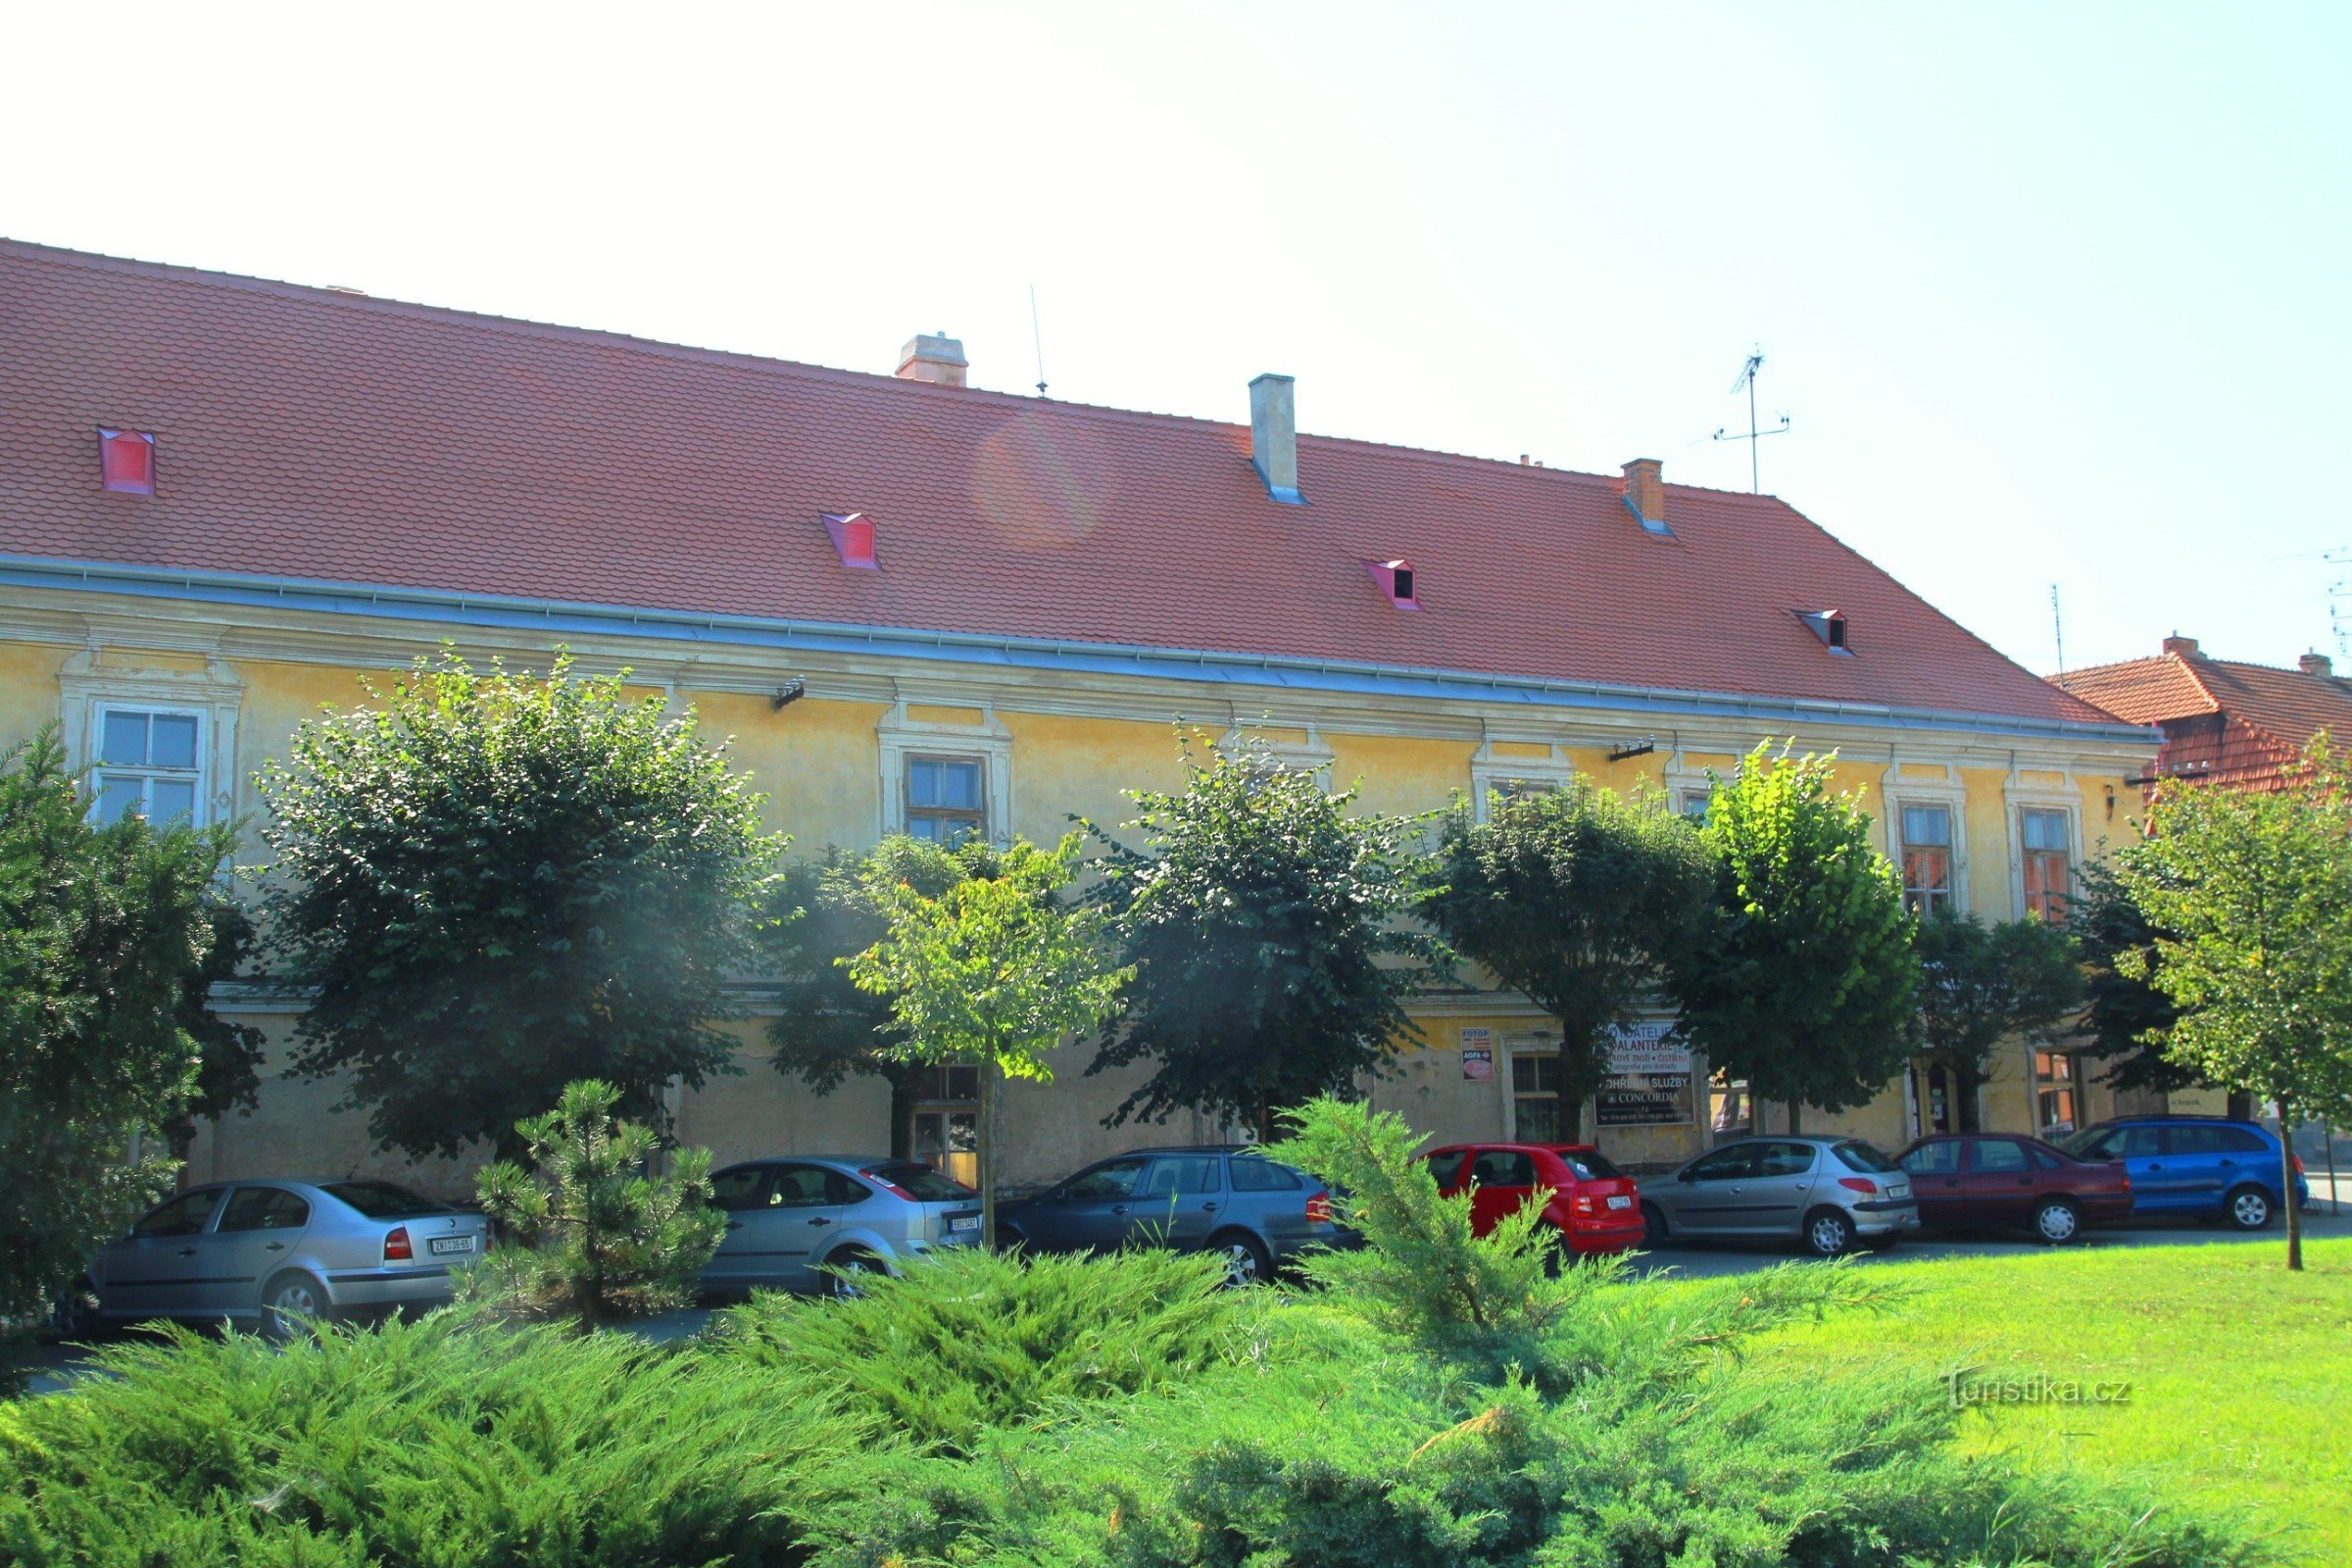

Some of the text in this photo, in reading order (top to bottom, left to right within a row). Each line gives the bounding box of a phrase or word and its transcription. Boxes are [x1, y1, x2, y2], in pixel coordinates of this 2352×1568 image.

[1607, 1026, 1677, 1039] OTOATELIE
[1605, 1075, 1688, 1090] OHŘEBNÍ SLUŽBY
[1618, 1092, 1680, 1103] CONCORDIA
